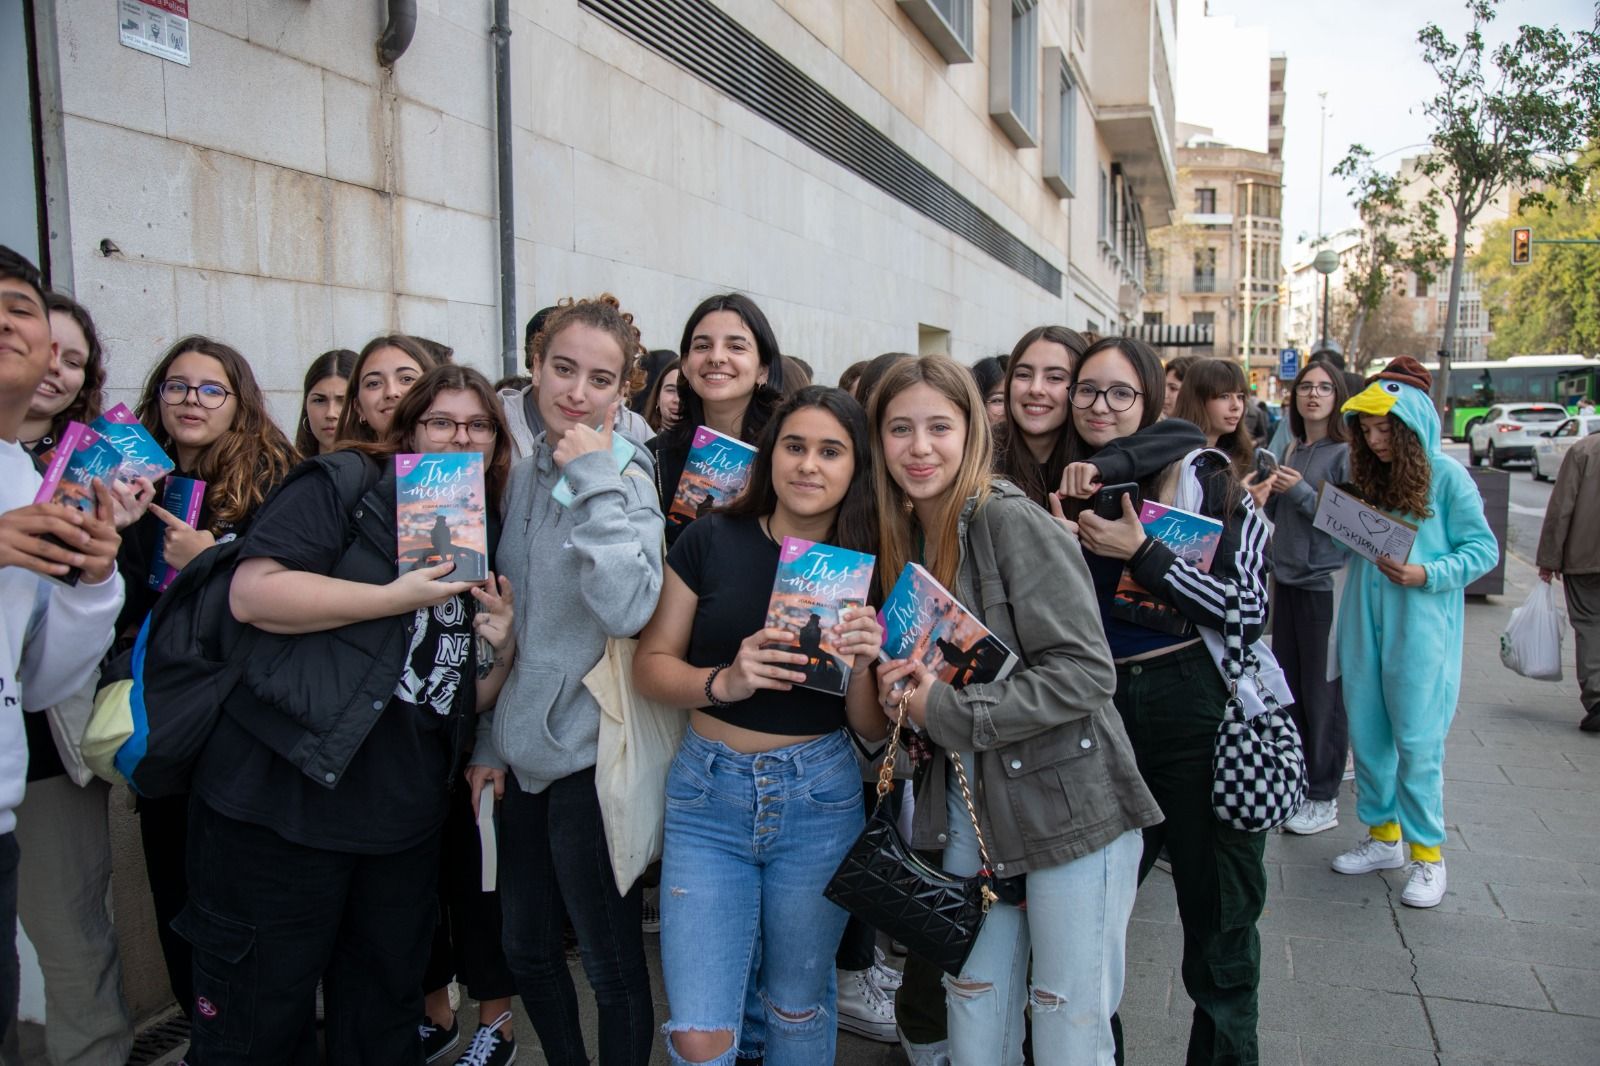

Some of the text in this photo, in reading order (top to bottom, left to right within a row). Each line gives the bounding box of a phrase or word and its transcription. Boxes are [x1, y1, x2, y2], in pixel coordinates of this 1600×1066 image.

[1283, 351, 1294, 364] P
[706, 443, 746, 473] Tres
[420, 459, 473, 487] Tres
[690, 460, 745, 486] meses
[403, 483, 472, 501] meses
[1158, 516, 1202, 545] Tres
[803, 552, 861, 583] Tres
[782, 576, 855, 601] meses
[887, 589, 921, 634] Tres
[896, 596, 935, 655] meses
